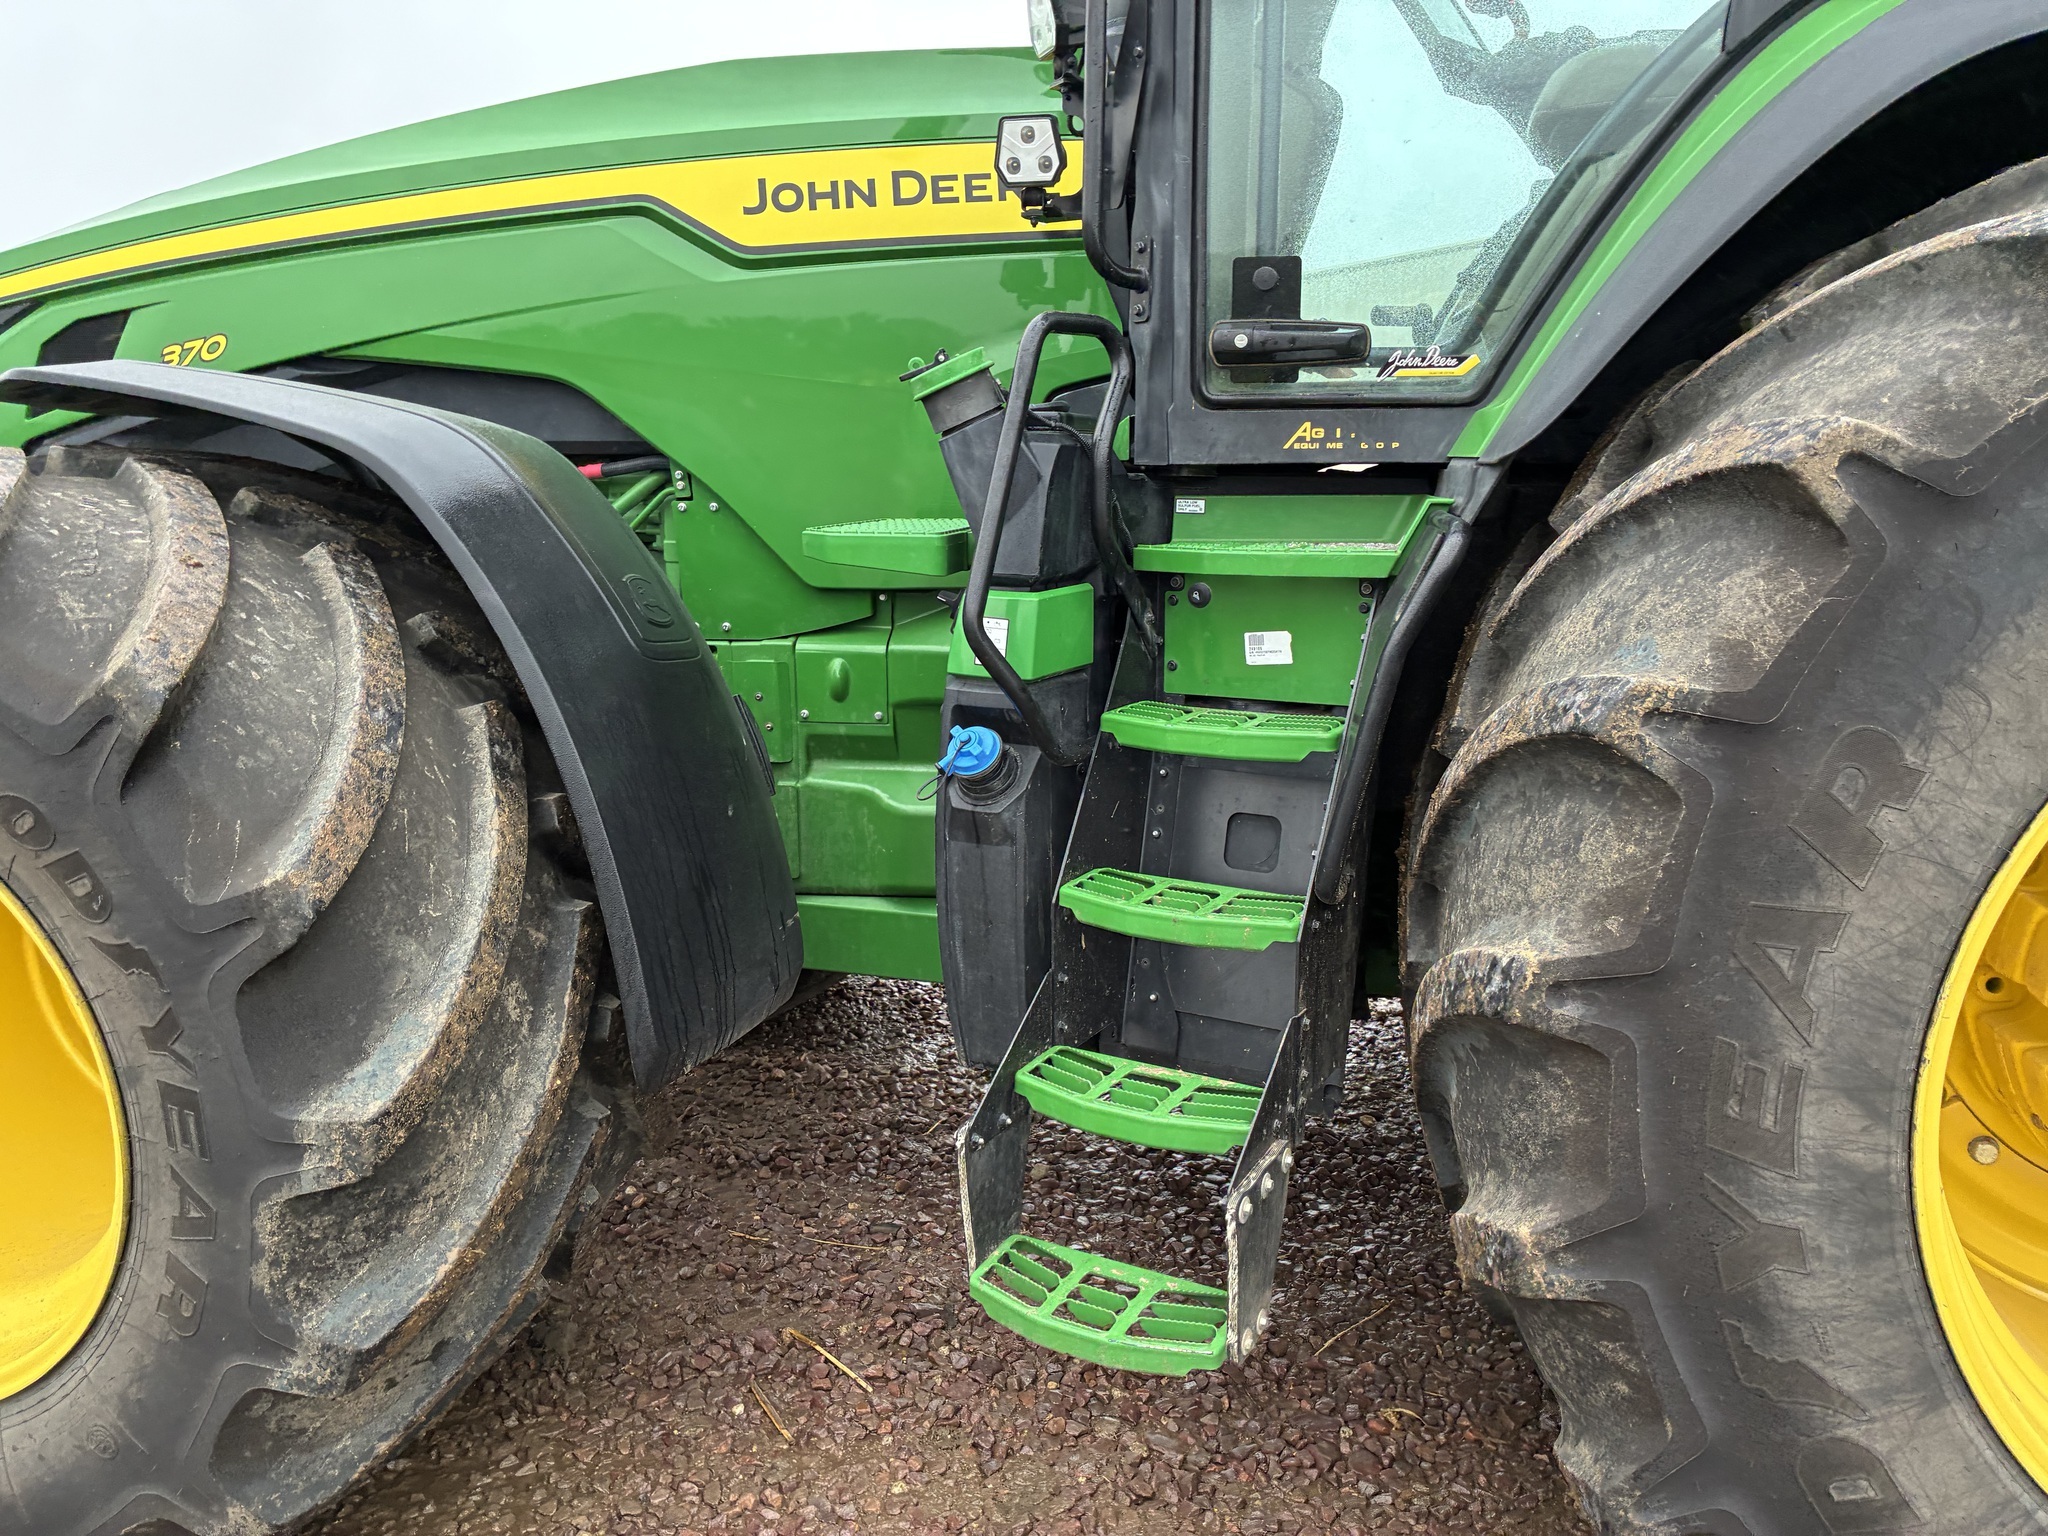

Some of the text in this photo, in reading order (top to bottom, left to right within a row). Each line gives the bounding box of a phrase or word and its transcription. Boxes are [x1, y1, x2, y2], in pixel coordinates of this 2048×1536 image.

[743, 169, 1022, 216] JOHN DEE
[161, 333, 228, 367] 370
[1423, 345, 1459, 367] Deere
